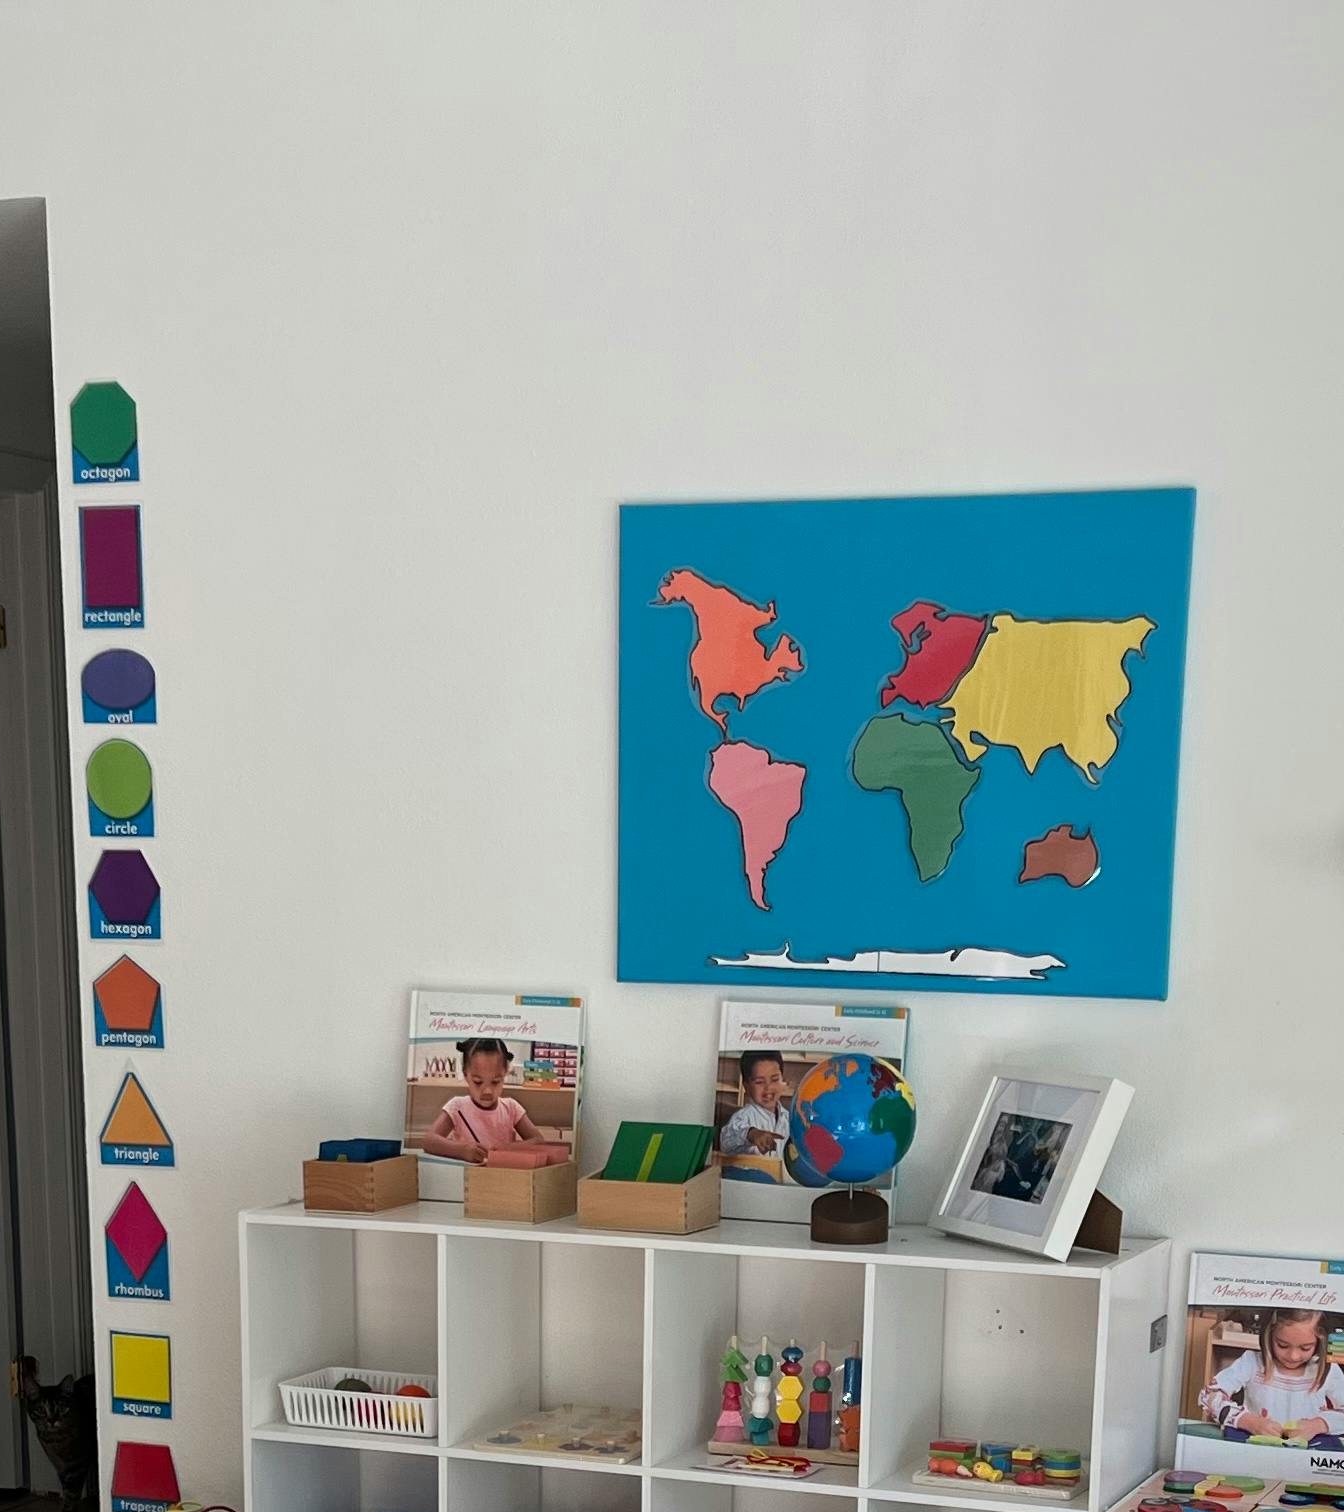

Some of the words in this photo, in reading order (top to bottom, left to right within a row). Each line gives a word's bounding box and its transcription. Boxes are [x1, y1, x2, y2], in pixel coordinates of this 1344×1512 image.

[81, 467, 131, 482] octagon
[85, 608, 142, 626] rectangle
[108, 710, 134, 724] oval
[105, 821, 138, 835] circle
[100, 920, 152, 938] hexagon
[101, 1031, 156, 1047] pentagon
[115, 1148, 159, 1163] triangle
[115, 1282, 164, 1298] rhombus
[1270, 1288, 1316, 1304] Practical
[1317, 1291, 1338, 1305] Life
[123, 1402, 162, 1416] square
